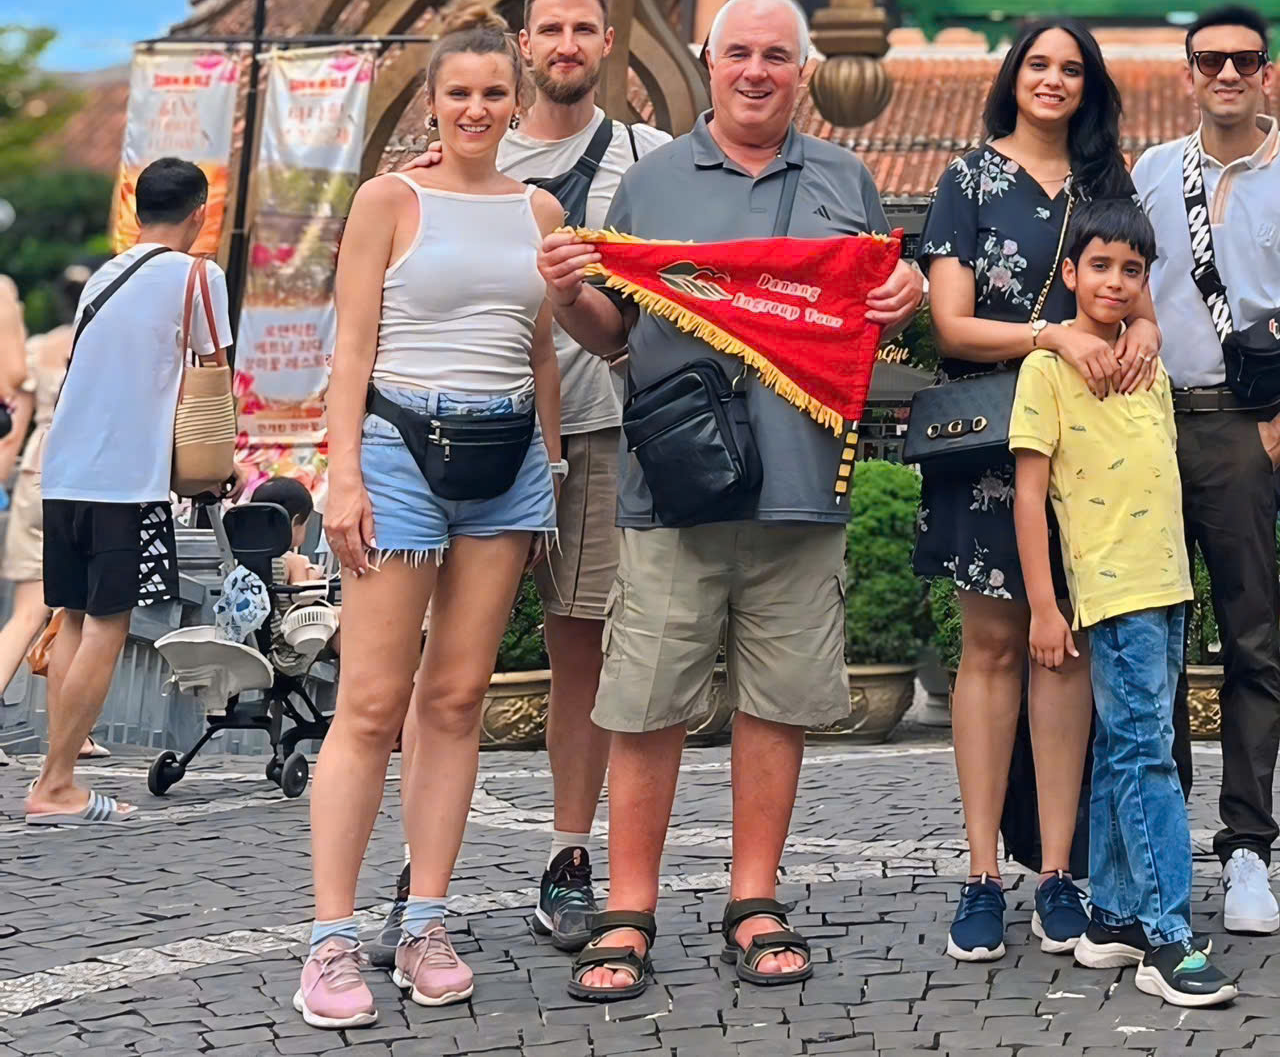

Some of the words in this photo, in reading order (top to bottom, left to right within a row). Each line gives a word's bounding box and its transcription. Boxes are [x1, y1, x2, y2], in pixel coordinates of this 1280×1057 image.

[757, 273, 822, 302] Danang
[732, 293, 800, 320] Ingroup
[804, 308, 843, 327] Tour
